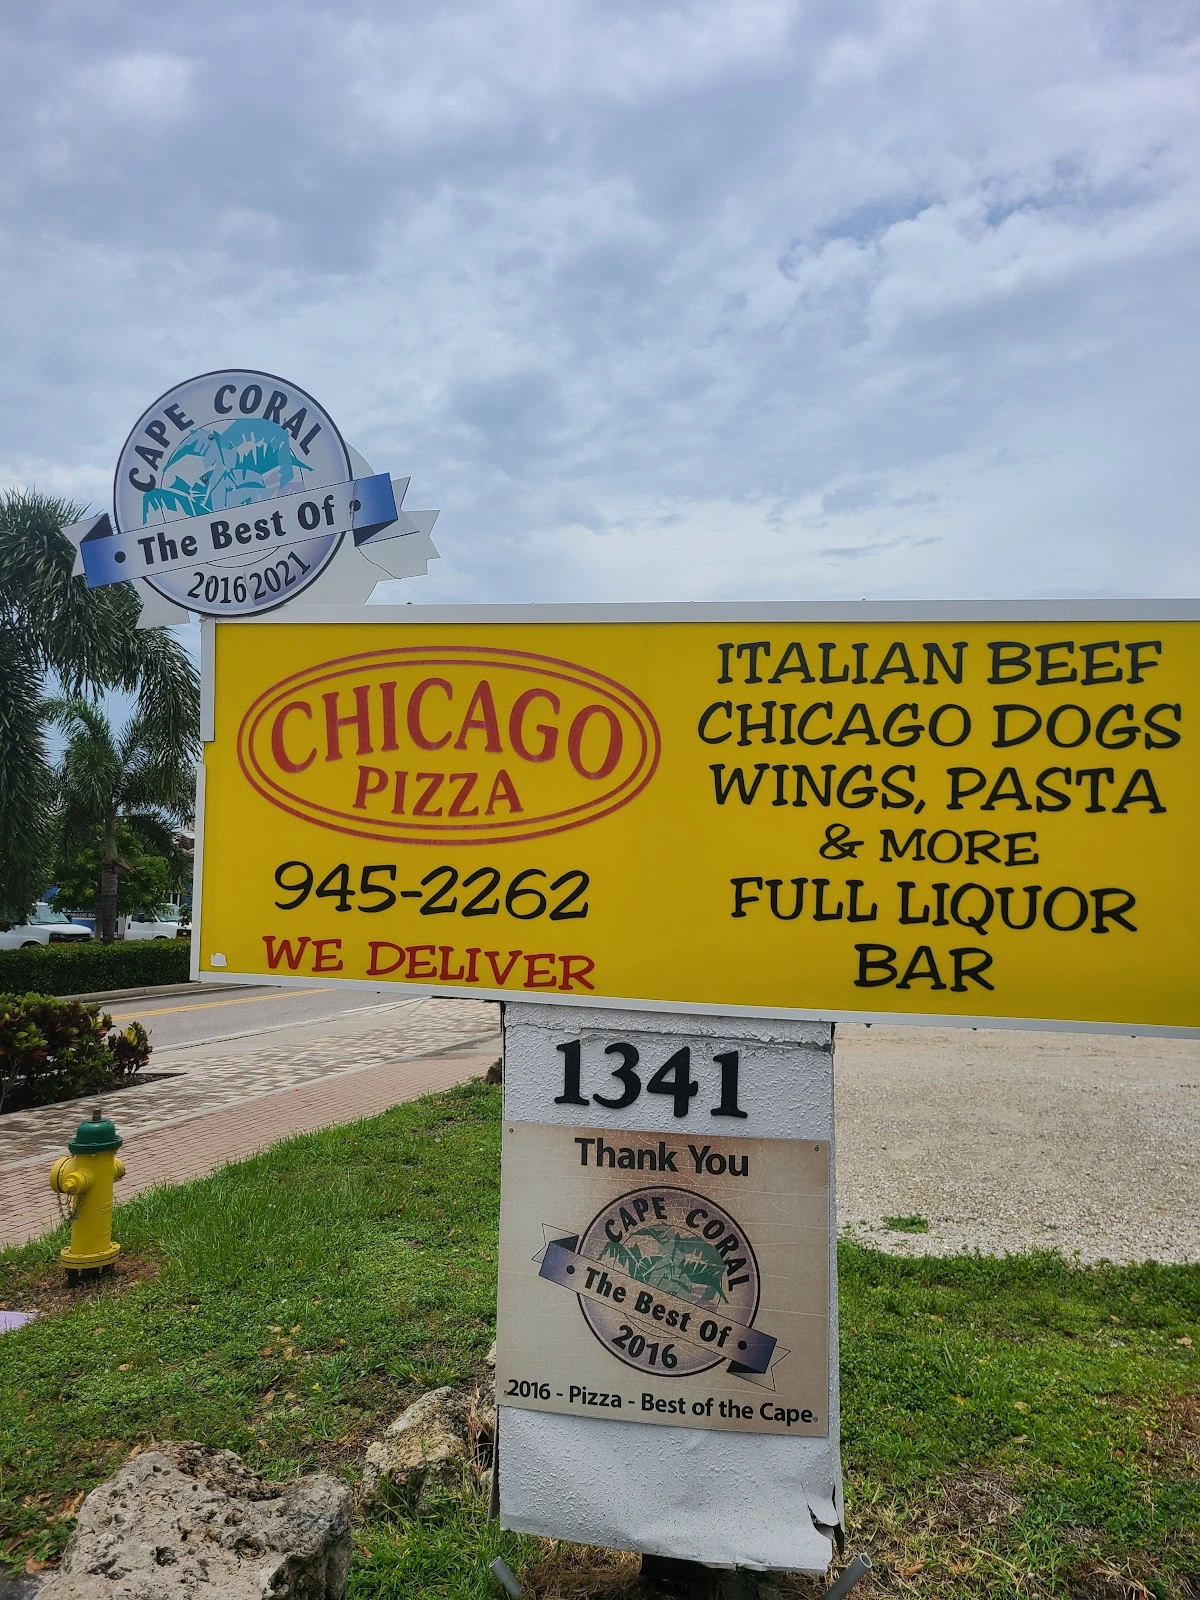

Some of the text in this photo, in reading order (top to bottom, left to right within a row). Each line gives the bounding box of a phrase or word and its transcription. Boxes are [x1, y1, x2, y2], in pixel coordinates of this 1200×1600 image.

[129, 384, 322, 493] CAPE CORAL
[137, 494, 335, 565] The Best Of
[187, 550, 311, 604] 2016 2021
[717, 640, 1162, 687] ITALIAN BEEF
[271, 677, 623, 781] CHICAGO
[697, 700, 1182, 750] CHICAGO DOGS
[352, 765, 524, 817] PIZZA
[709, 762, 1167, 815] WINGS, PASTA
[818, 823, 1039, 867] & MORE
[274, 860, 590, 921] 945-2262
[730, 876, 1138, 936] FULL LIQUOR
[262, 935, 595, 991] WE DELIVER
[854, 943, 995, 992] BAR
[554, 1039, 748, 1119] 1341
[574, 1137, 750, 1177] Thank You
[604, 1196, 750, 1292] CAPE CORAL
[584, 1266, 732, 1349] The Best Of
[611, 1324, 678, 1369] 2016
[507, 1379, 551, 1400] 2016
[569, 1385, 622, 1409] Pizza
[641, 1392, 686, 1415] Best
[691, 1398, 714, 1417] of
[719, 1399, 754, 1419] the
[759, 1402, 813, 1427] Cape
